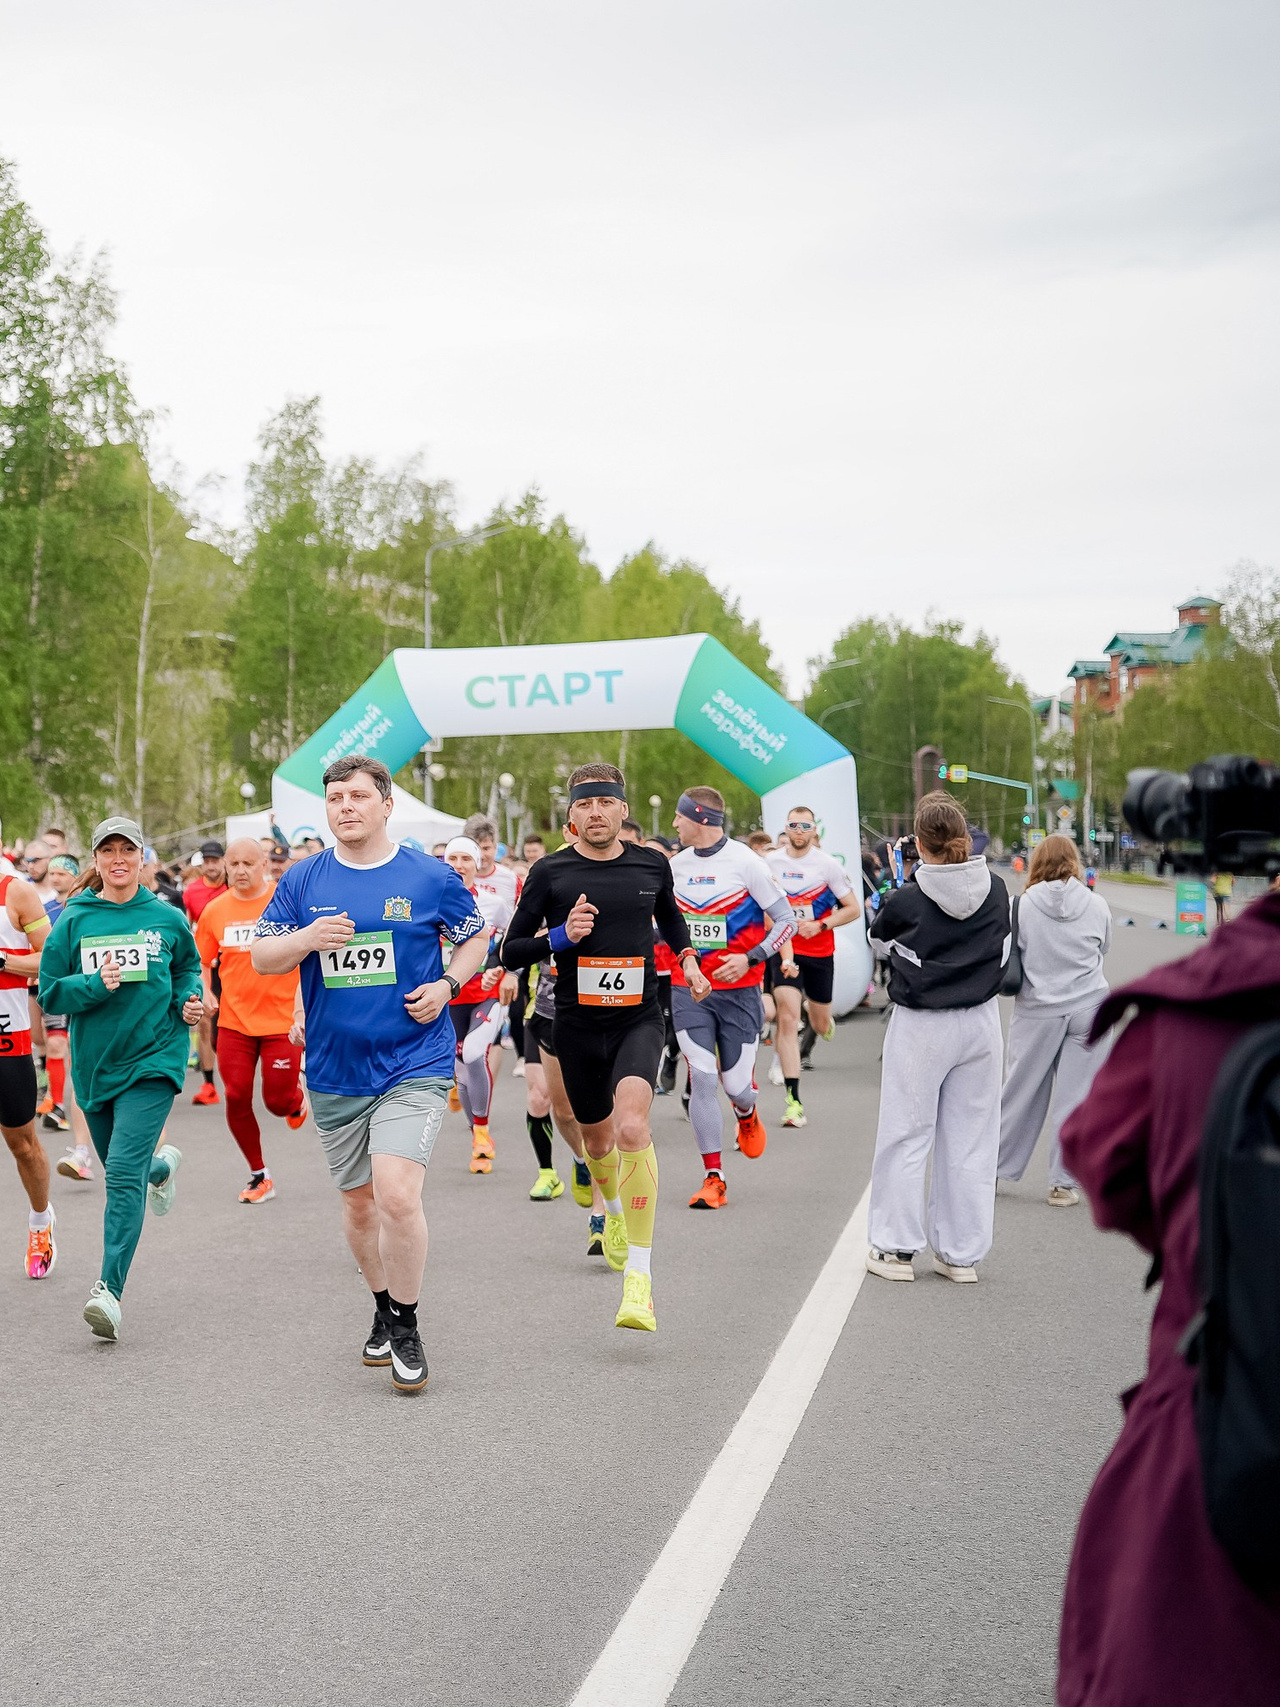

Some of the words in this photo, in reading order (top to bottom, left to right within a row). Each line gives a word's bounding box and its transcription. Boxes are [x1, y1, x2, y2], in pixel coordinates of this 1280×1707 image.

[465, 670, 624, 710] СТАРТ
[712, 689, 788, 753] зелёный
[701, 702, 773, 765] марафон
[687, 924, 721, 938] 1589
[328, 947, 387, 972] 1499
[346, 976, 371, 986] 4,2км
[598, 972, 625, 991] 46
[601, 995, 624, 1004] 21,1км
